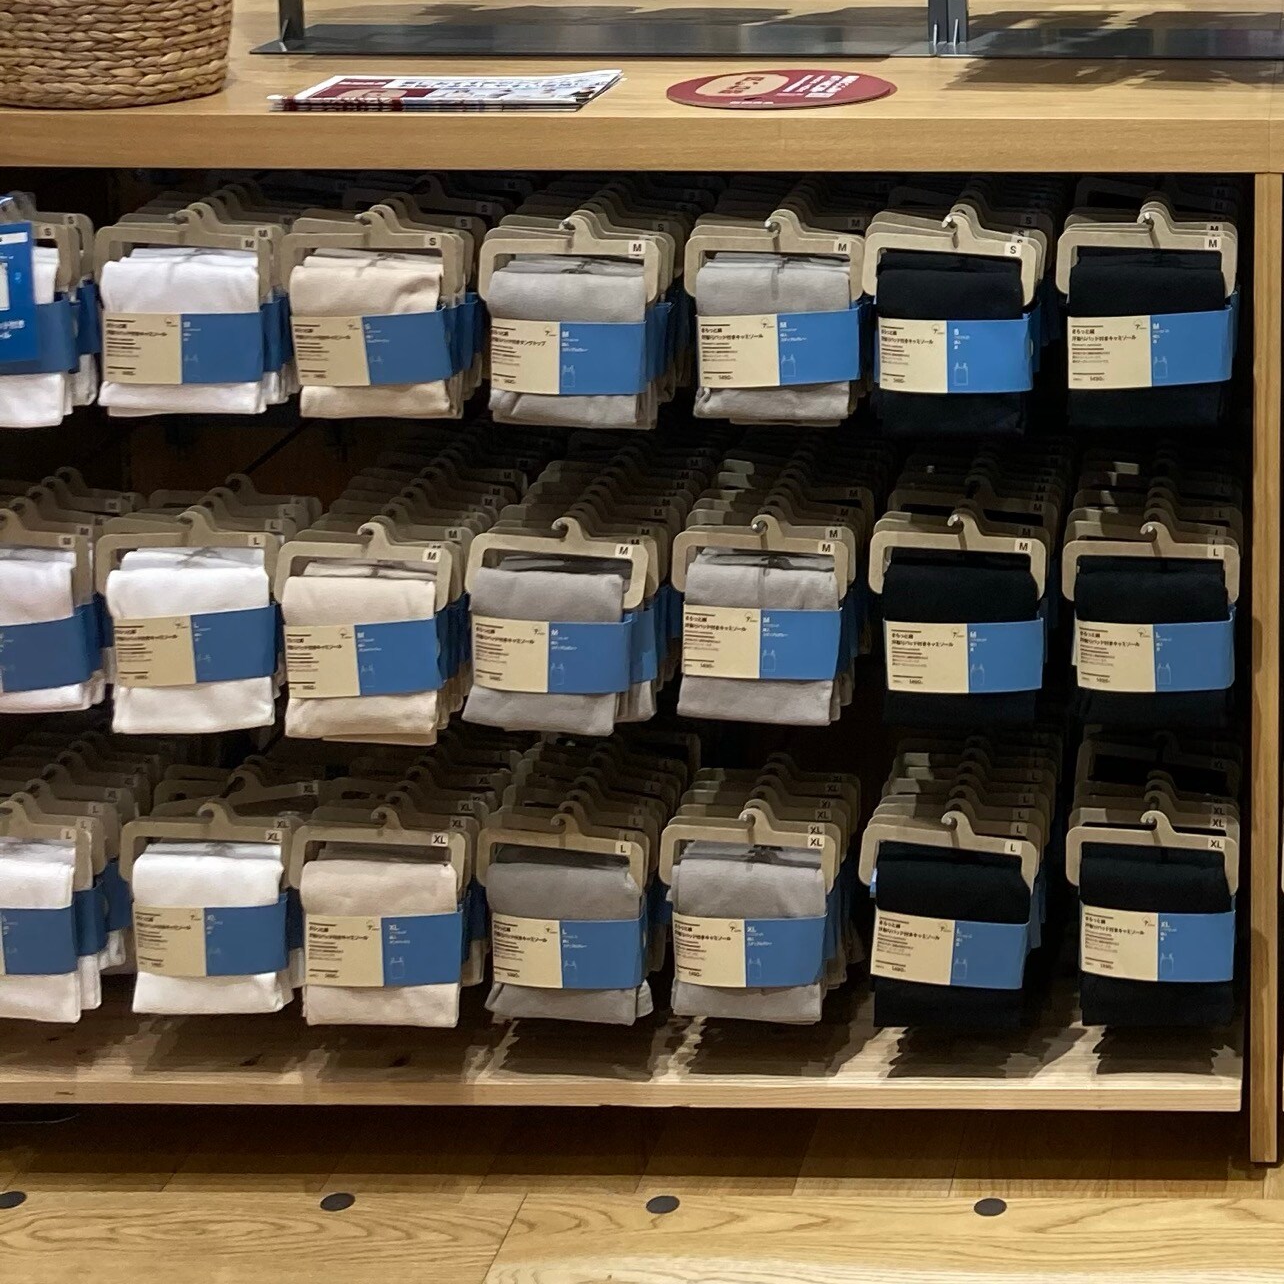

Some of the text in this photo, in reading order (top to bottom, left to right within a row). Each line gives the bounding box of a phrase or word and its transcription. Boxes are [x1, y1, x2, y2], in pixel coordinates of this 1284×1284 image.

[632, 243, 642, 253] M
[837, 242, 847, 252] M
[1208, 239, 1218, 248] M
[1009, 245, 1017, 255] S
[619, 546, 629, 555] M
[821, 544, 831, 553] M
[1018, 542, 1028, 551] M
[426, 551, 438, 561] M
[1212, 547, 1219, 556] L
[1212, 818, 1224, 828] XL
[267, 830, 281, 841] XL
[433, 834, 447, 845] XL
[810, 838, 823, 847] XL
[1210, 839, 1223, 849] XL
[619, 844, 626, 853] L
[1009, 843, 1016, 852] L
